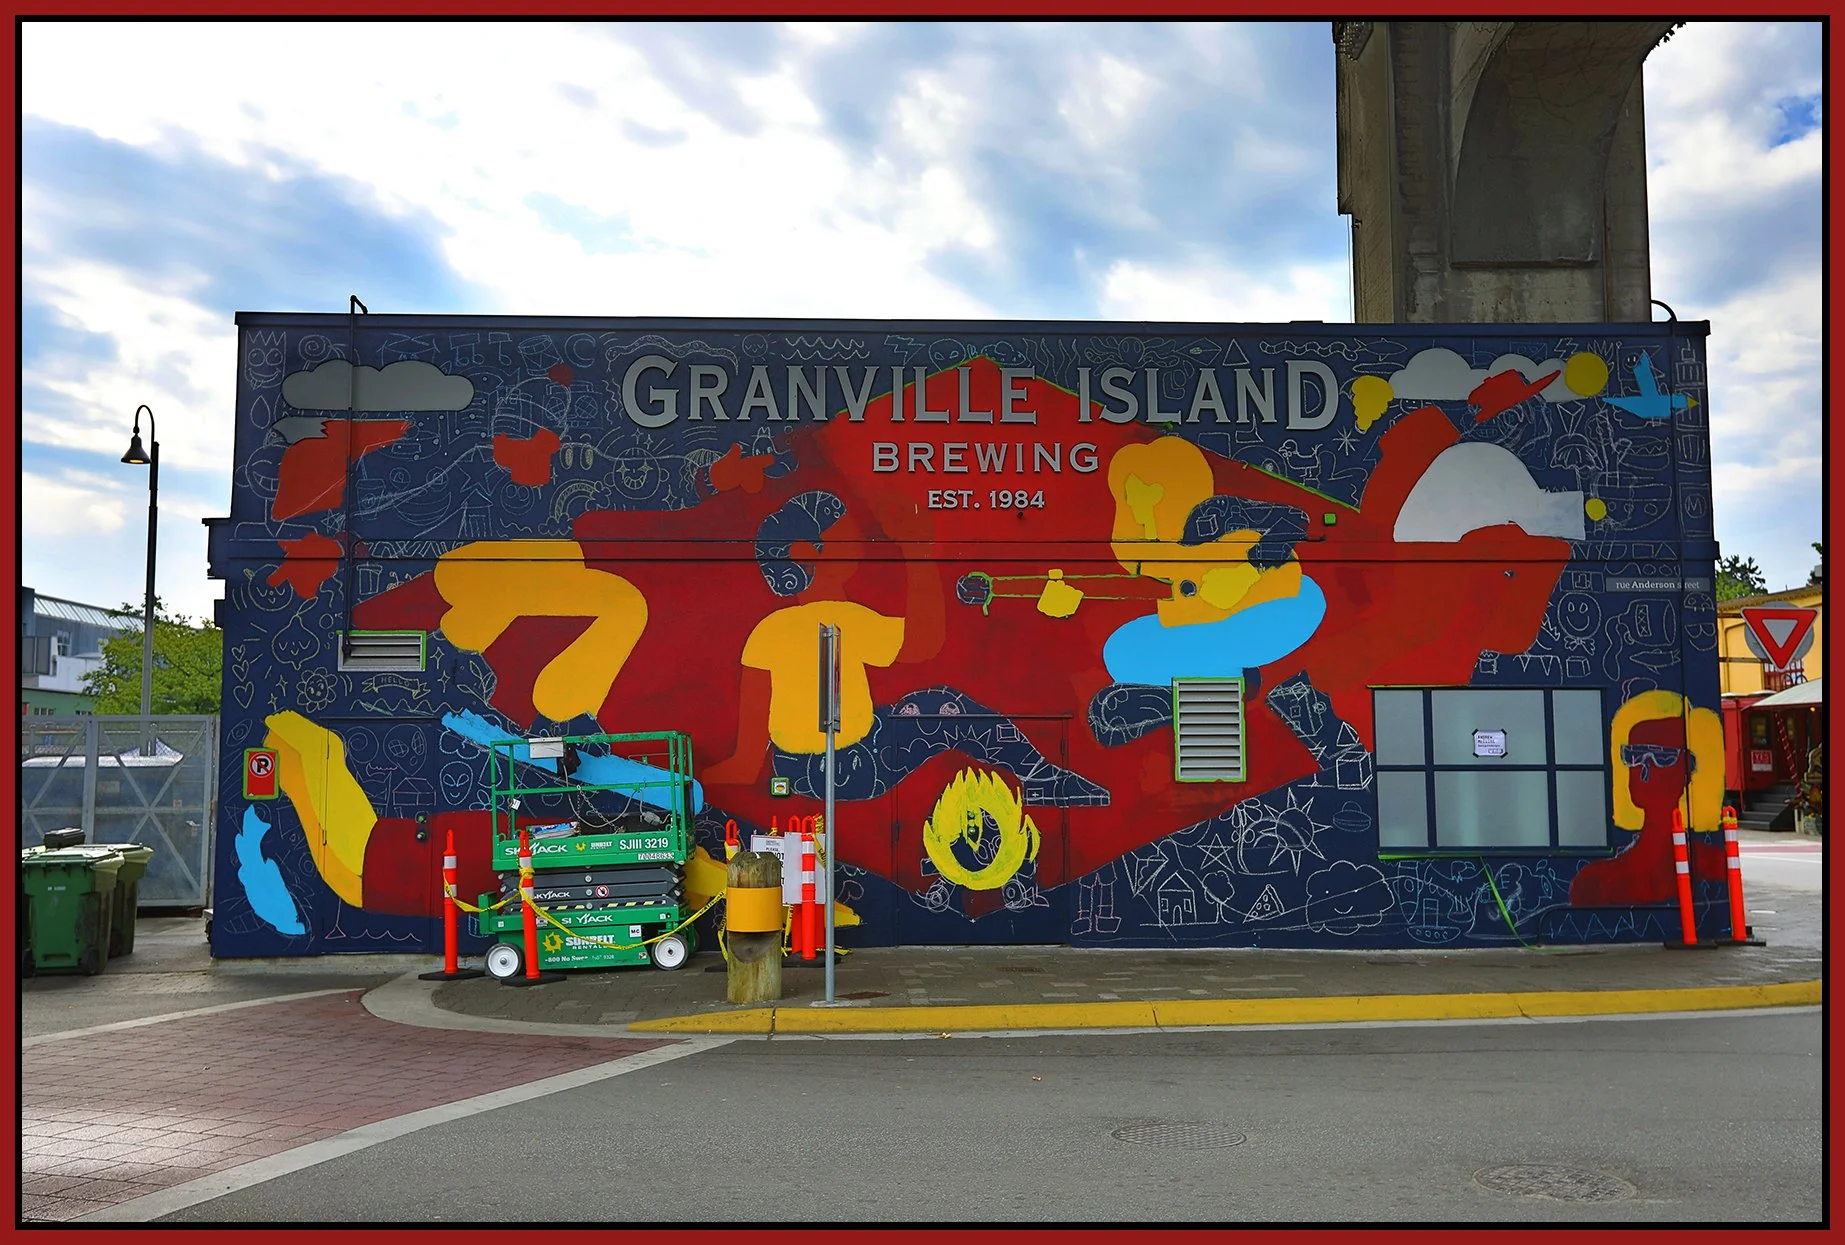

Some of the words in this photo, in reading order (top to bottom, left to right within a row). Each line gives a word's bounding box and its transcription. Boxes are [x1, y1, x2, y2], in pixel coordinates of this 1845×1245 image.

[621, 354, 1038, 428] GRANVILLE
[1077, 360, 1339, 430] ISLAND
[872, 442, 1099, 474] BREWING
[927, 490, 981, 510] EST.
[989, 490, 1046, 510] 1984
[1631, 580, 1676, 589] Anderson
[1677, 581, 1700, 589] sreet
[380, 676, 410, 687] HELLO
[644, 837, 669, 849] 3219
